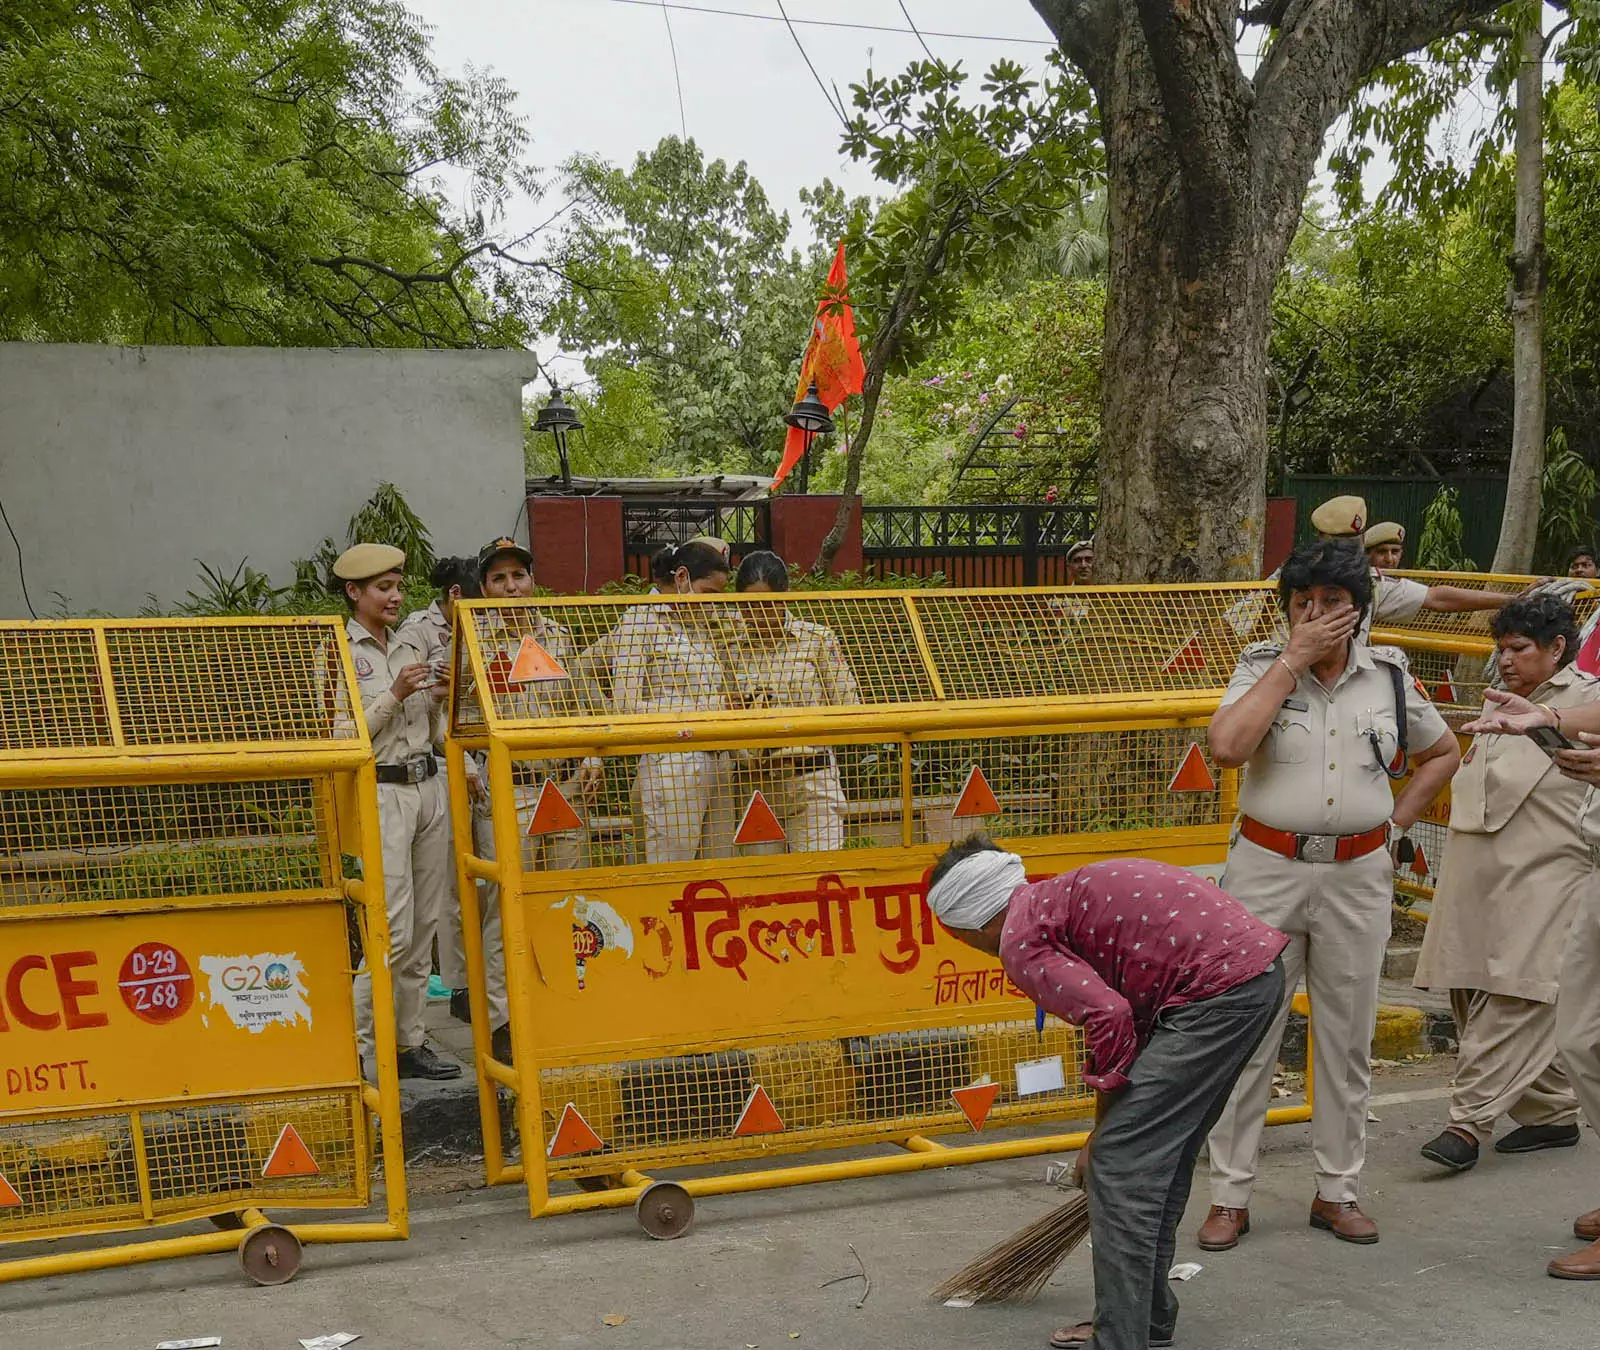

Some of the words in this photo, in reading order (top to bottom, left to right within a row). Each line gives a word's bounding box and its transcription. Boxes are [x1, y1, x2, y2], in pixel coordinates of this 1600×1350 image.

[668, 873, 861, 982] दिल्ली
[132, 949, 178, 975] D-29
[133, 982, 180, 1011] 268
[5, 1059, 97, 1096] DISTT.
